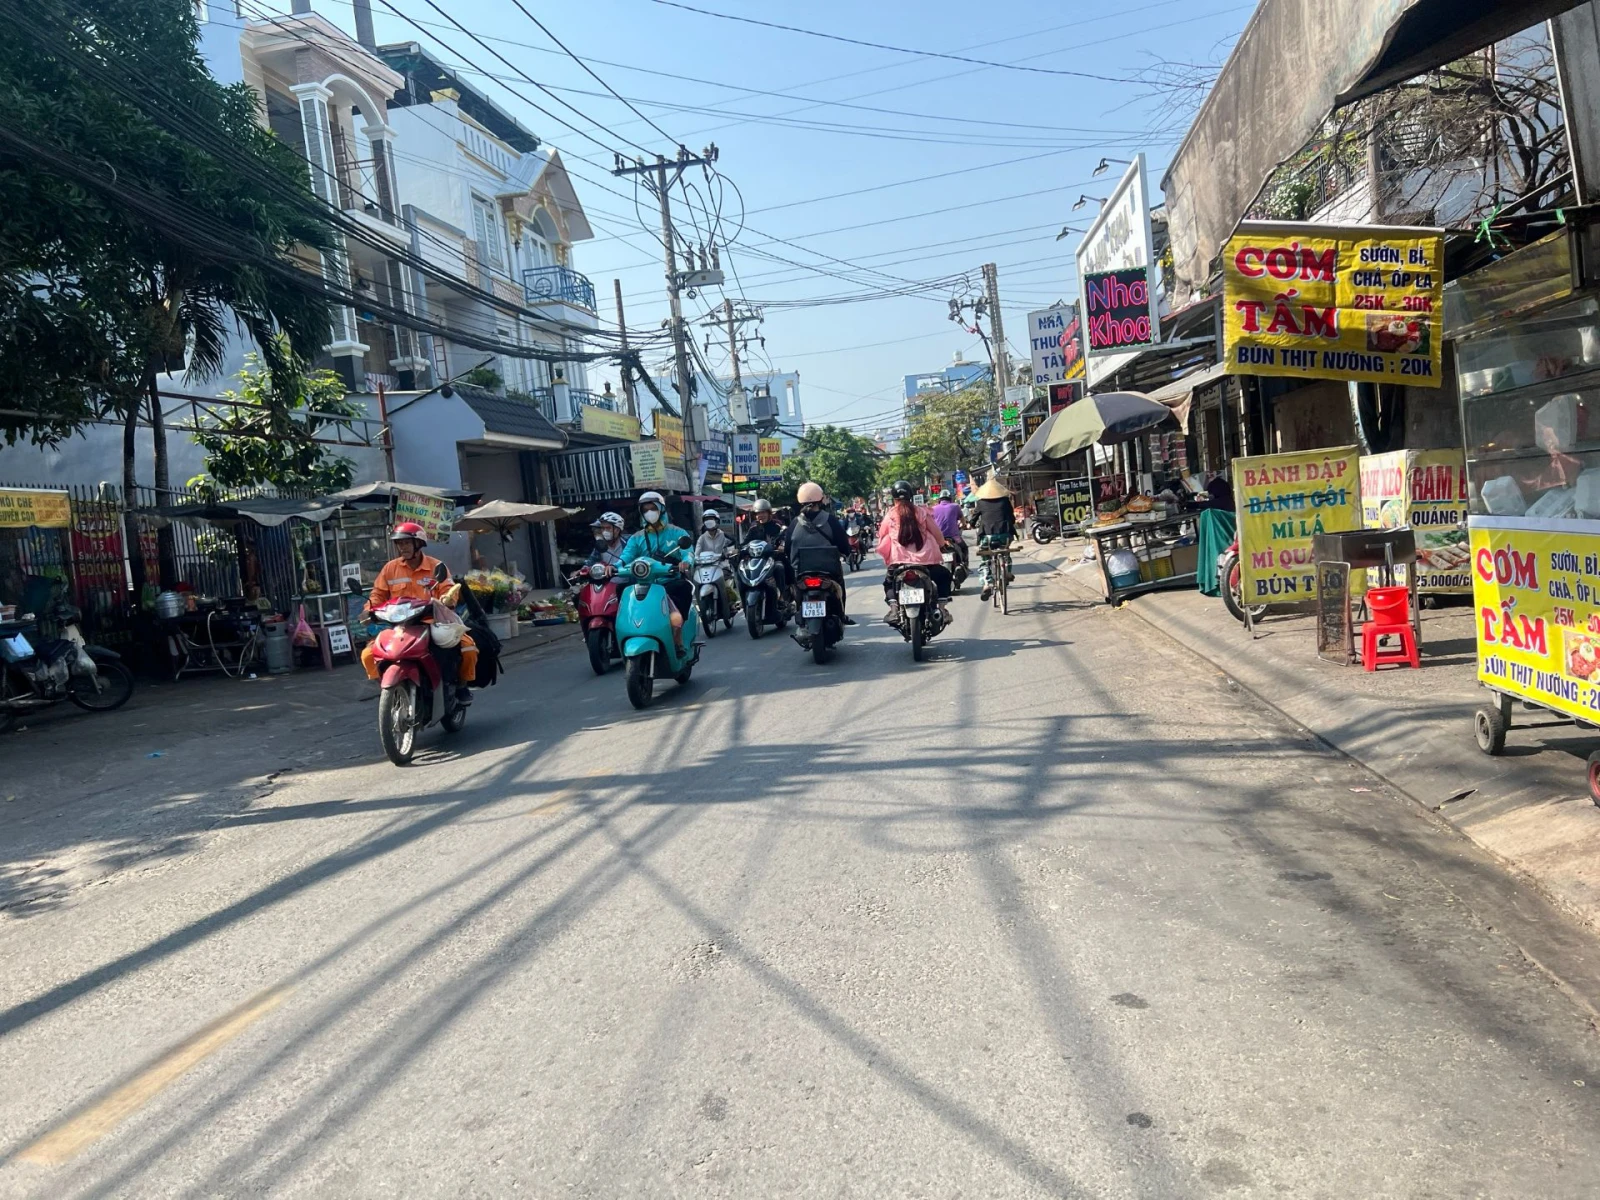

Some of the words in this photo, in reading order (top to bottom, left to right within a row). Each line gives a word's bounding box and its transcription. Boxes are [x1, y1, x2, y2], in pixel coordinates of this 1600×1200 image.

[1235, 242, 1338, 283] CƠM
[1360, 247, 1404, 265] SƯỜN,
[1410, 246, 1428, 266] BÌ,
[1353, 268, 1386, 289] CHẢ,
[1391, 268, 1412, 287] ỐP
[1416, 274, 1432, 289] LA
[1088, 275, 1148, 311] Nha
[1354, 294, 1385, 310] 25K
[1402, 296, 1432, 312] 30K
[1236, 288, 1338, 338] TẤM
[1090, 312, 1152, 346] Khoa
[1042, 352, 1067, 369] TÂY
[1238, 342, 1274, 364] BÚN
[1282, 349, 1318, 371] THỊT
[1323, 350, 1384, 372] NƯỚNG
[1402, 358, 1432, 376] 20K
[1036, 374, 1052, 384] DS.
[735, 452, 756, 462] THUỐC
[739, 442, 752, 450] NHÀ
[740, 464, 752, 473] TÂY
[1244, 464, 1300, 486] BÁNH
[1306, 457, 1346, 482] ĐẬP
[1250, 491, 1306, 514] BÁNH
[1272, 516, 1295, 539] MÌ
[1300, 514, 1325, 536] LÁ
[1412, 506, 1458, 526] QUẢNG
[1252, 547, 1274, 569] MÌ
[1477, 543, 1540, 591] CƠM
[1551, 550, 1582, 576] SƯỜN,
[1256, 573, 1296, 596] BÚN
[1549, 577, 1574, 601] CHẢ,
[1577, 578, 1590, 601] ỐP
[1593, 587, 1600, 605] L
[1482, 596, 1548, 656] TẤM
[1554, 606, 1576, 627] 25K
[1510, 662, 1533, 688] THỊT
[1536, 670, 1578, 702] NƯỚNG
